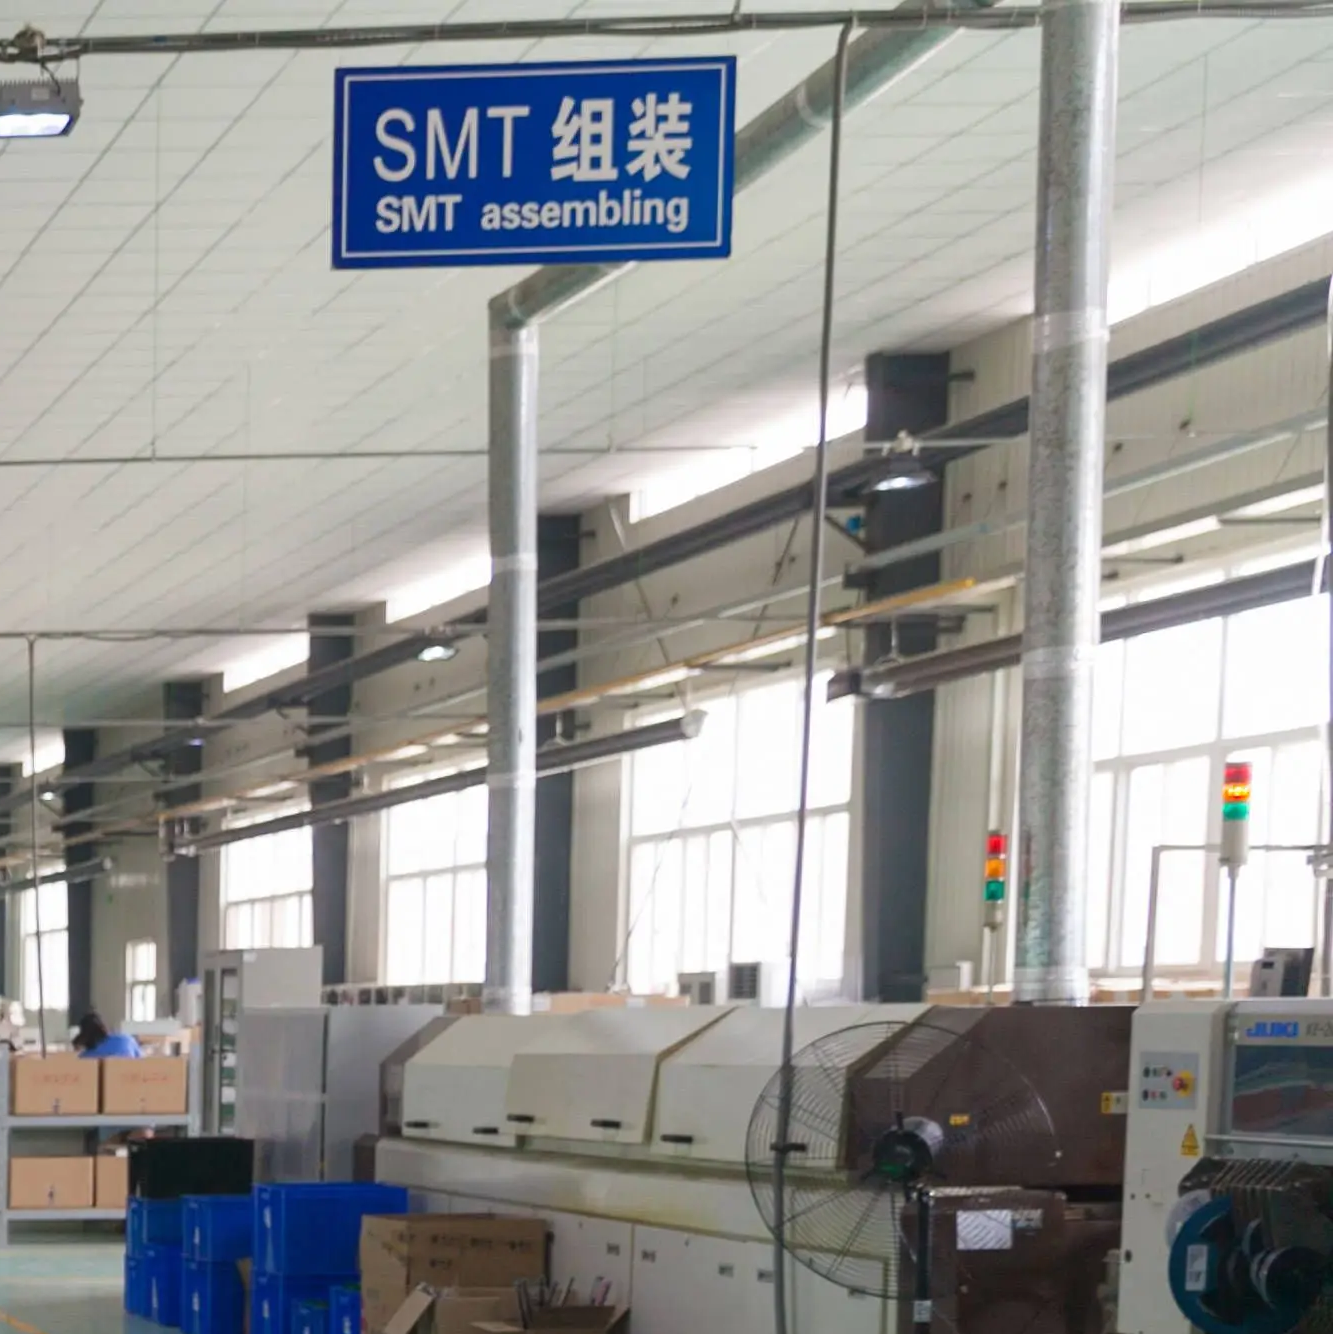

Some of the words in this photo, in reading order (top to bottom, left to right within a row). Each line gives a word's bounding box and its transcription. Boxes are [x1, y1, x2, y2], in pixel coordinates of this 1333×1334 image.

[373, 106, 530, 182] SMT
[549, 92, 694, 183] 组装
[375, 194, 463, 233] SMT
[480, 189, 690, 233] assembling
